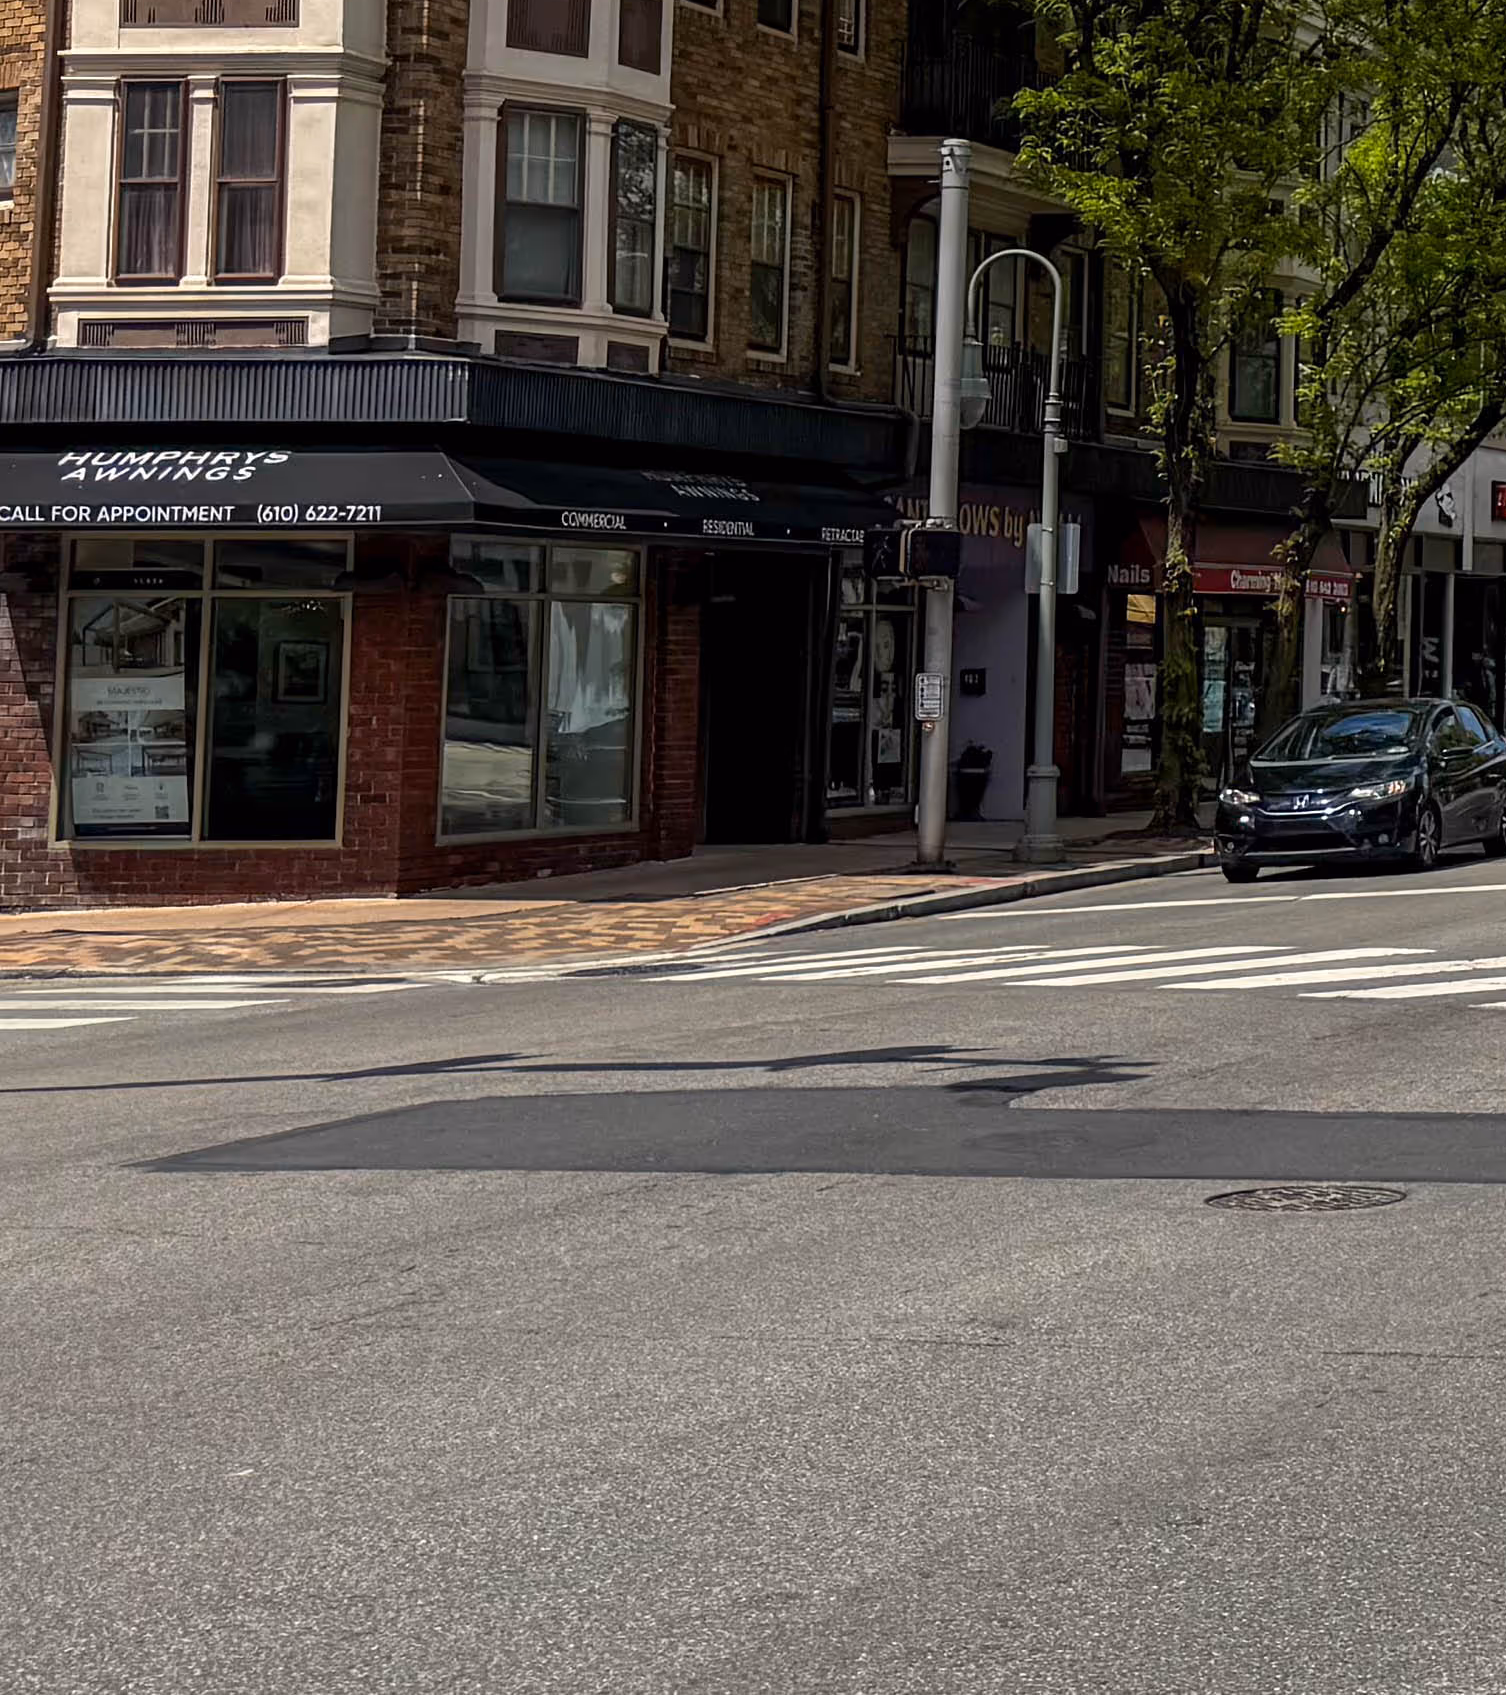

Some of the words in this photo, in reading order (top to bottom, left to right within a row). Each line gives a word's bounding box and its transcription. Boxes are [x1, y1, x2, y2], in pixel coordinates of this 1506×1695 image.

[58, 450, 293, 466] HUMPHRYS
[61, 466, 257, 482] AWNINGS
[0, 505, 45, 523] CALL
[51, 505, 91, 523] FOR
[96, 505, 235, 523] APPOINTMENT
[256, 504, 299, 524] (610)
[304, 504, 382, 523] 622-7211
[561, 510, 627, 530] COMMERCIAL
[703, 518, 755, 537] RESIDENTIAL
[821, 526, 865, 543] RETRACTAB
[1004, 509, 1024, 547] by
[1107, 564, 1151, 585] Nails
